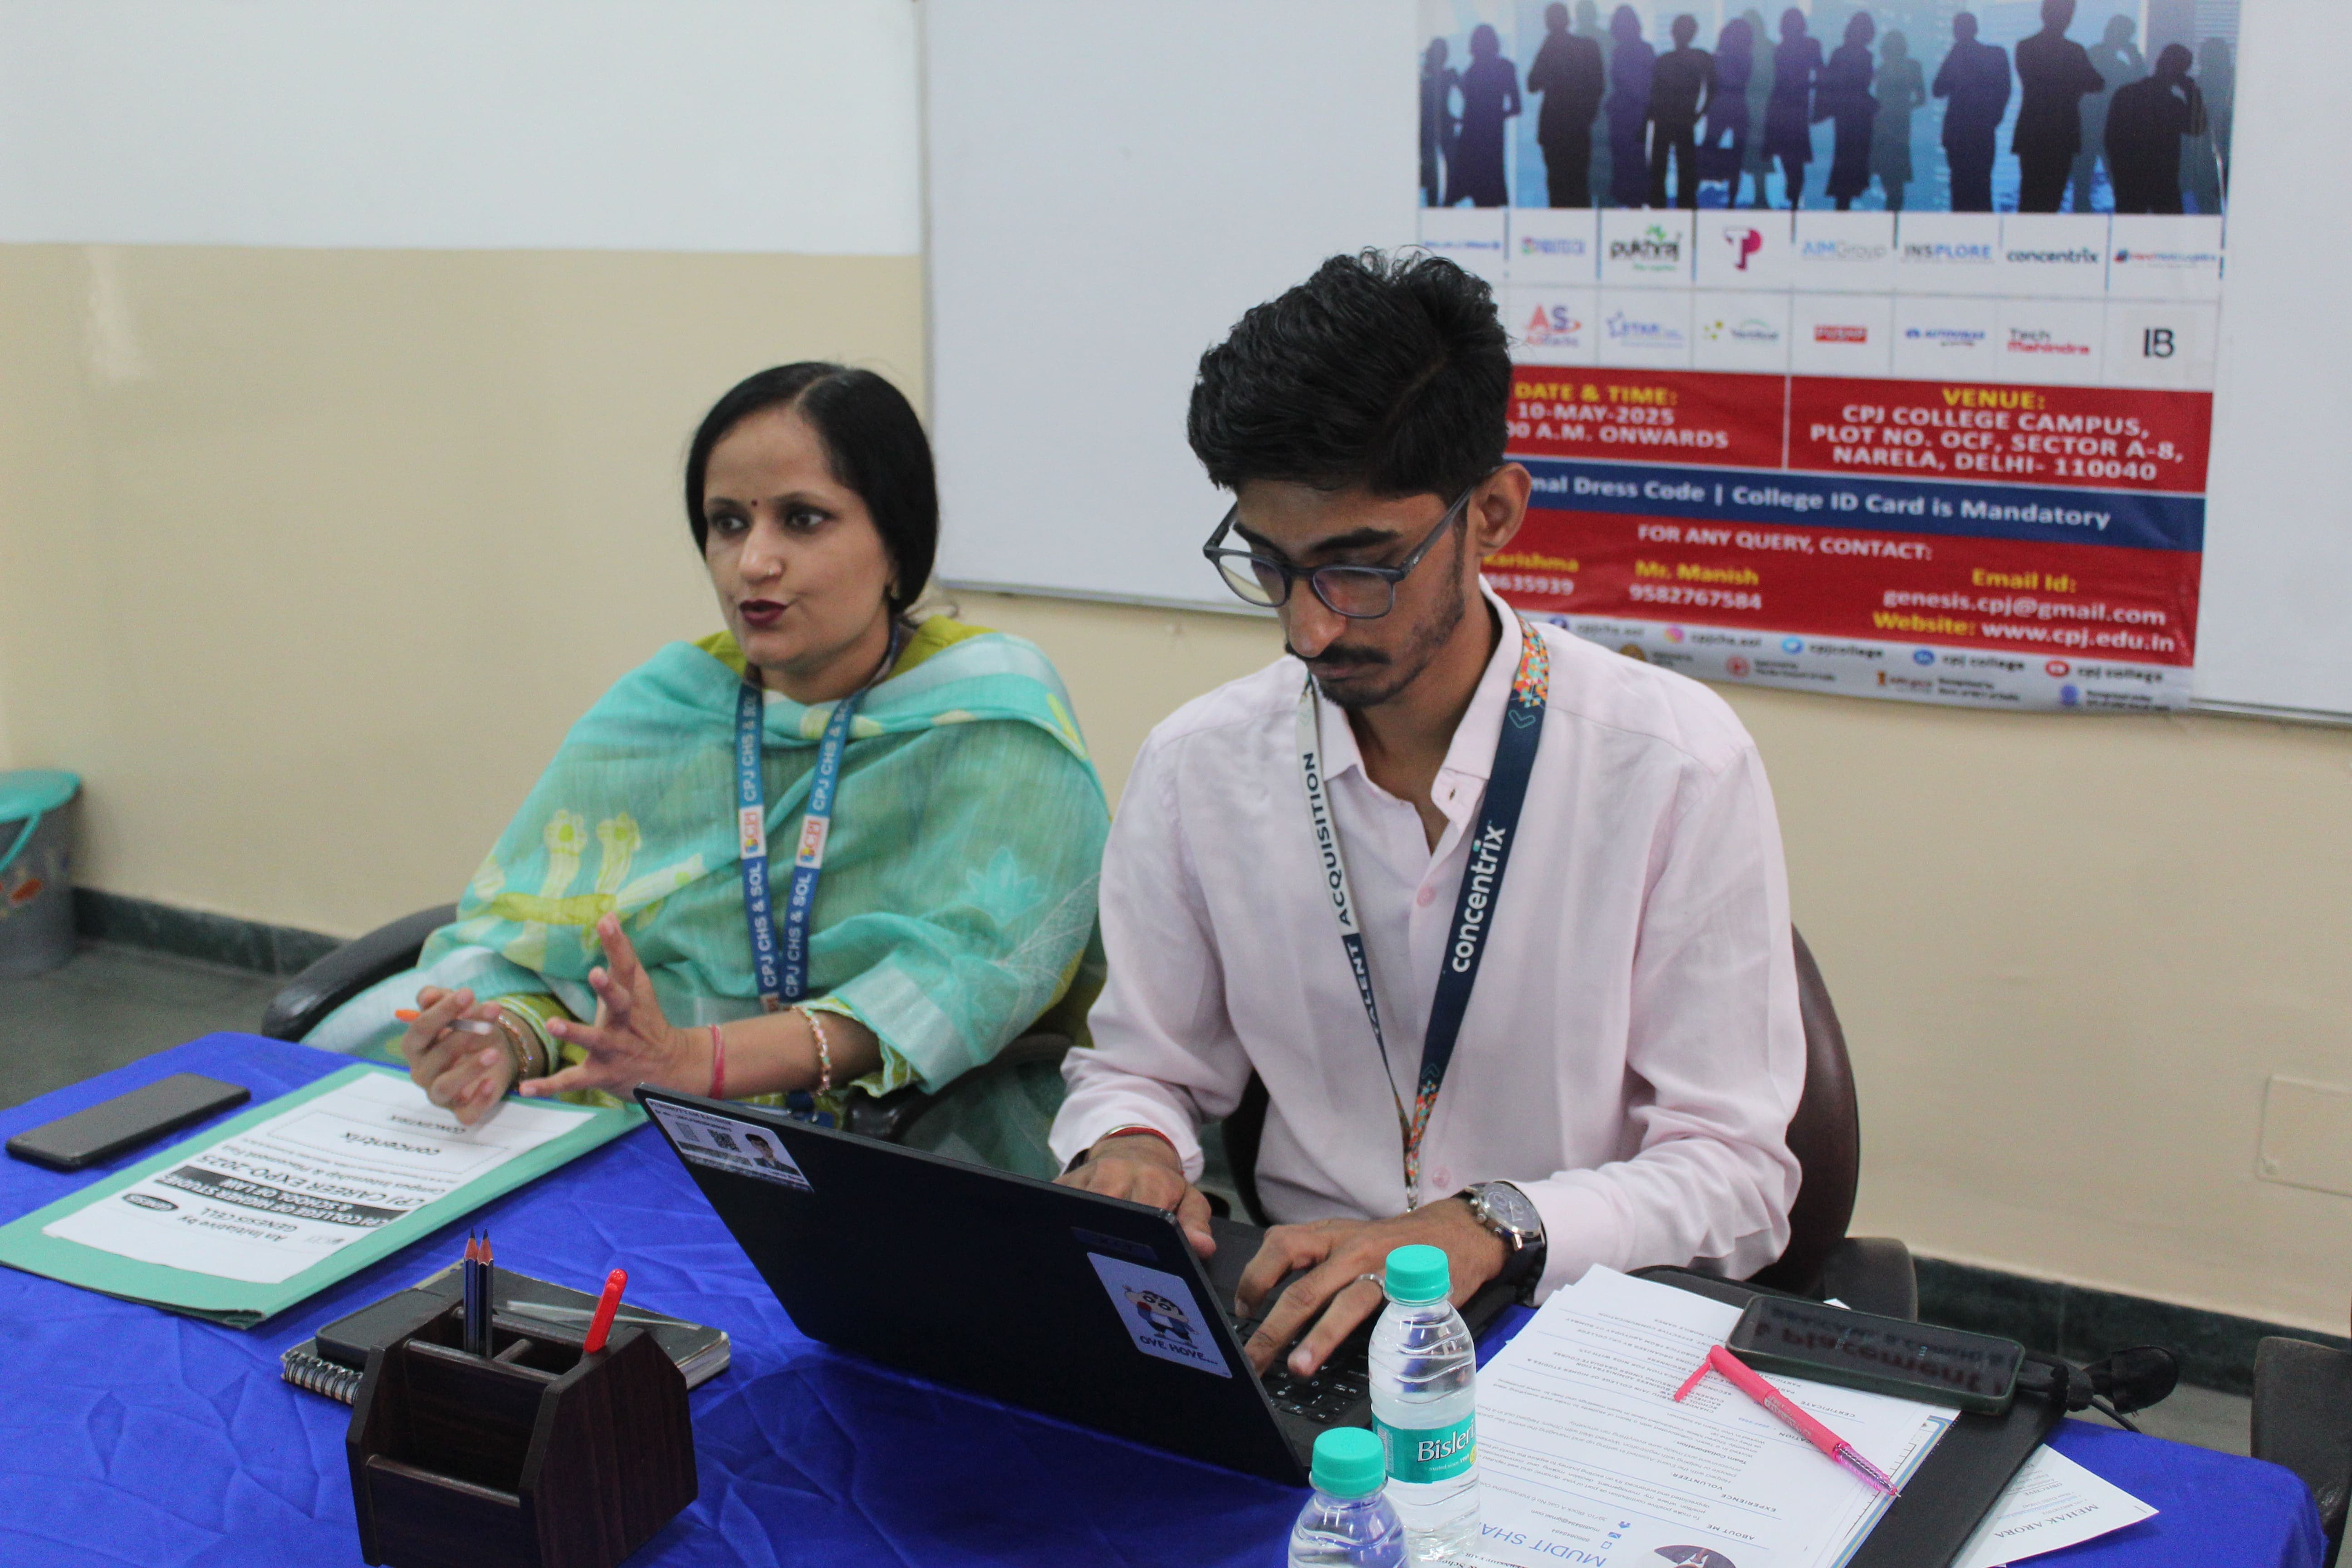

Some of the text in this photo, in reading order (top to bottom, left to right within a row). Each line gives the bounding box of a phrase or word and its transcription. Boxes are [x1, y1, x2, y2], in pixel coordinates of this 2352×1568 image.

[1906, 244, 1991, 259] INSPLORE
[2007, 247, 2099, 263] concentrix
[2010, 328, 2050, 340] Tech
[2008, 340, 2091, 354] Mahindra
[1514, 382, 1677, 406] DATE & TIME:
[1942, 387, 2046, 410] VENUE:
[1519, 402, 1675, 426] 10-MAY-2025
[1842, 405, 2150, 440] CPJ COLLEGE CAMPUS,
[1536, 422, 1593, 441] A.M.
[1599, 425, 1729, 448] ONWARDS
[1810, 423, 2184, 464] PLOT NO. OCF, SECTOR A-8,
[1833, 446, 2157, 481] NARELA, DELHI- 110040
[1574, 477, 1638, 498] Dress
[1644, 480, 1705, 502] Code
[1733, 485, 1824, 512] College
[1831, 493, 1858, 511] ID
[1865, 494, 1924, 516] Card
[1931, 498, 1953, 518] is
[1960, 499, 2110, 531] Mandatory
[1638, 524, 1933, 561] FOR ANY QUERY, CONTACT:
[1636, 560, 1759, 585] Mr. Manish
[1971, 568, 2077, 593] Email Id:
[1883, 590, 2166, 626] genesis.cpj@gmail.com
[1872, 611, 2176, 652] Website: www.cpj.edu.in
[828, 726, 842, 738] &
[740, 735, 755, 767] CHS
[821, 740, 838, 775] CHS
[742, 770, 756, 801] CPJ
[812, 778, 829, 811] CPJ
[1301, 750, 1353, 929] ACQUISITION
[1451, 824, 1506, 974] concentrix
[748, 862, 779, 987] CPJ CHS & SOL
[785, 873, 812, 997] CPJ CHS & SOL
[391, 1116, 470, 1134] CONCENTRIX
[345, 1132, 441, 1155] concentrix
[246, 1152, 311, 1171] Placement
[152, 1173, 218, 1194] STUDIES
[201, 1156, 425, 1205] CPJ CAREER EXPO-2025
[222, 1180, 255, 1192] LAW
[326, 1172, 392, 1187] Internship
[395, 1183, 446, 1193] Campus
[217, 1191, 273, 1207] HIGHER
[280, 1191, 336, 1209] SCHOOL
[202, 1207, 298, 1230] GENESIS CELL
[295, 1204, 361, 1223] COLLEGE
[181, 1216, 284, 1242] An Initiative by
[1801, 1401, 1855, 1417] CERTIFICATE
[1417, 1418, 1474, 1463] Bisleri
[1677, 1441, 1746, 1465] Team Collaboration
[1672, 1473, 1722, 1490] VOLUNTEER:
[1608, 1491, 1646, 1504] contribution
[1647, 1502, 1672, 1511] positive
[1680, 1505, 1706, 1514] position
[1722, 1494, 1776, 1512] EXPERIENCE
[1994, 1504, 2098, 1538] MEHAK ARORA
[1479, 1523, 1606, 1567] MUDIT SHA
[1724, 1529, 1754, 1540] ABOUT
